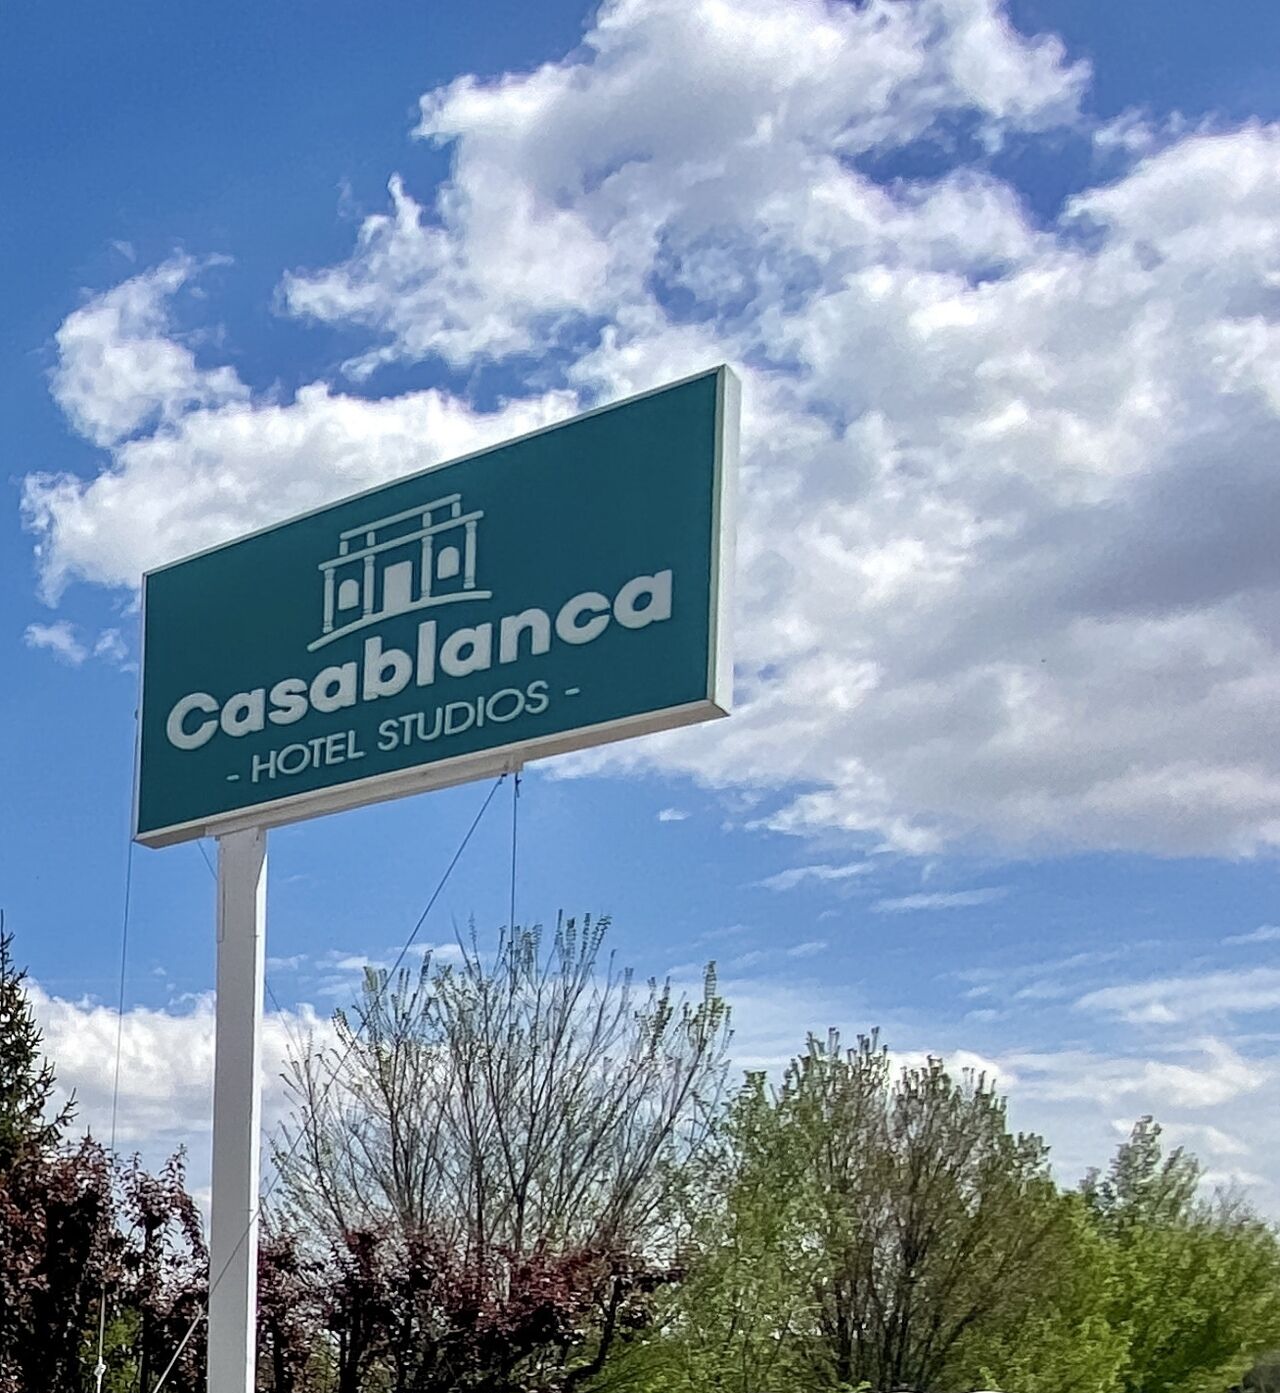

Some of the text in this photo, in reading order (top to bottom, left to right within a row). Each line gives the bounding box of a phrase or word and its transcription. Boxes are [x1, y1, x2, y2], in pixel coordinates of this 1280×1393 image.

[166, 568, 674, 750] Casablanca
[251, 730, 364, 783] HOTEL
[378, 681, 549, 751] STUDIOS
